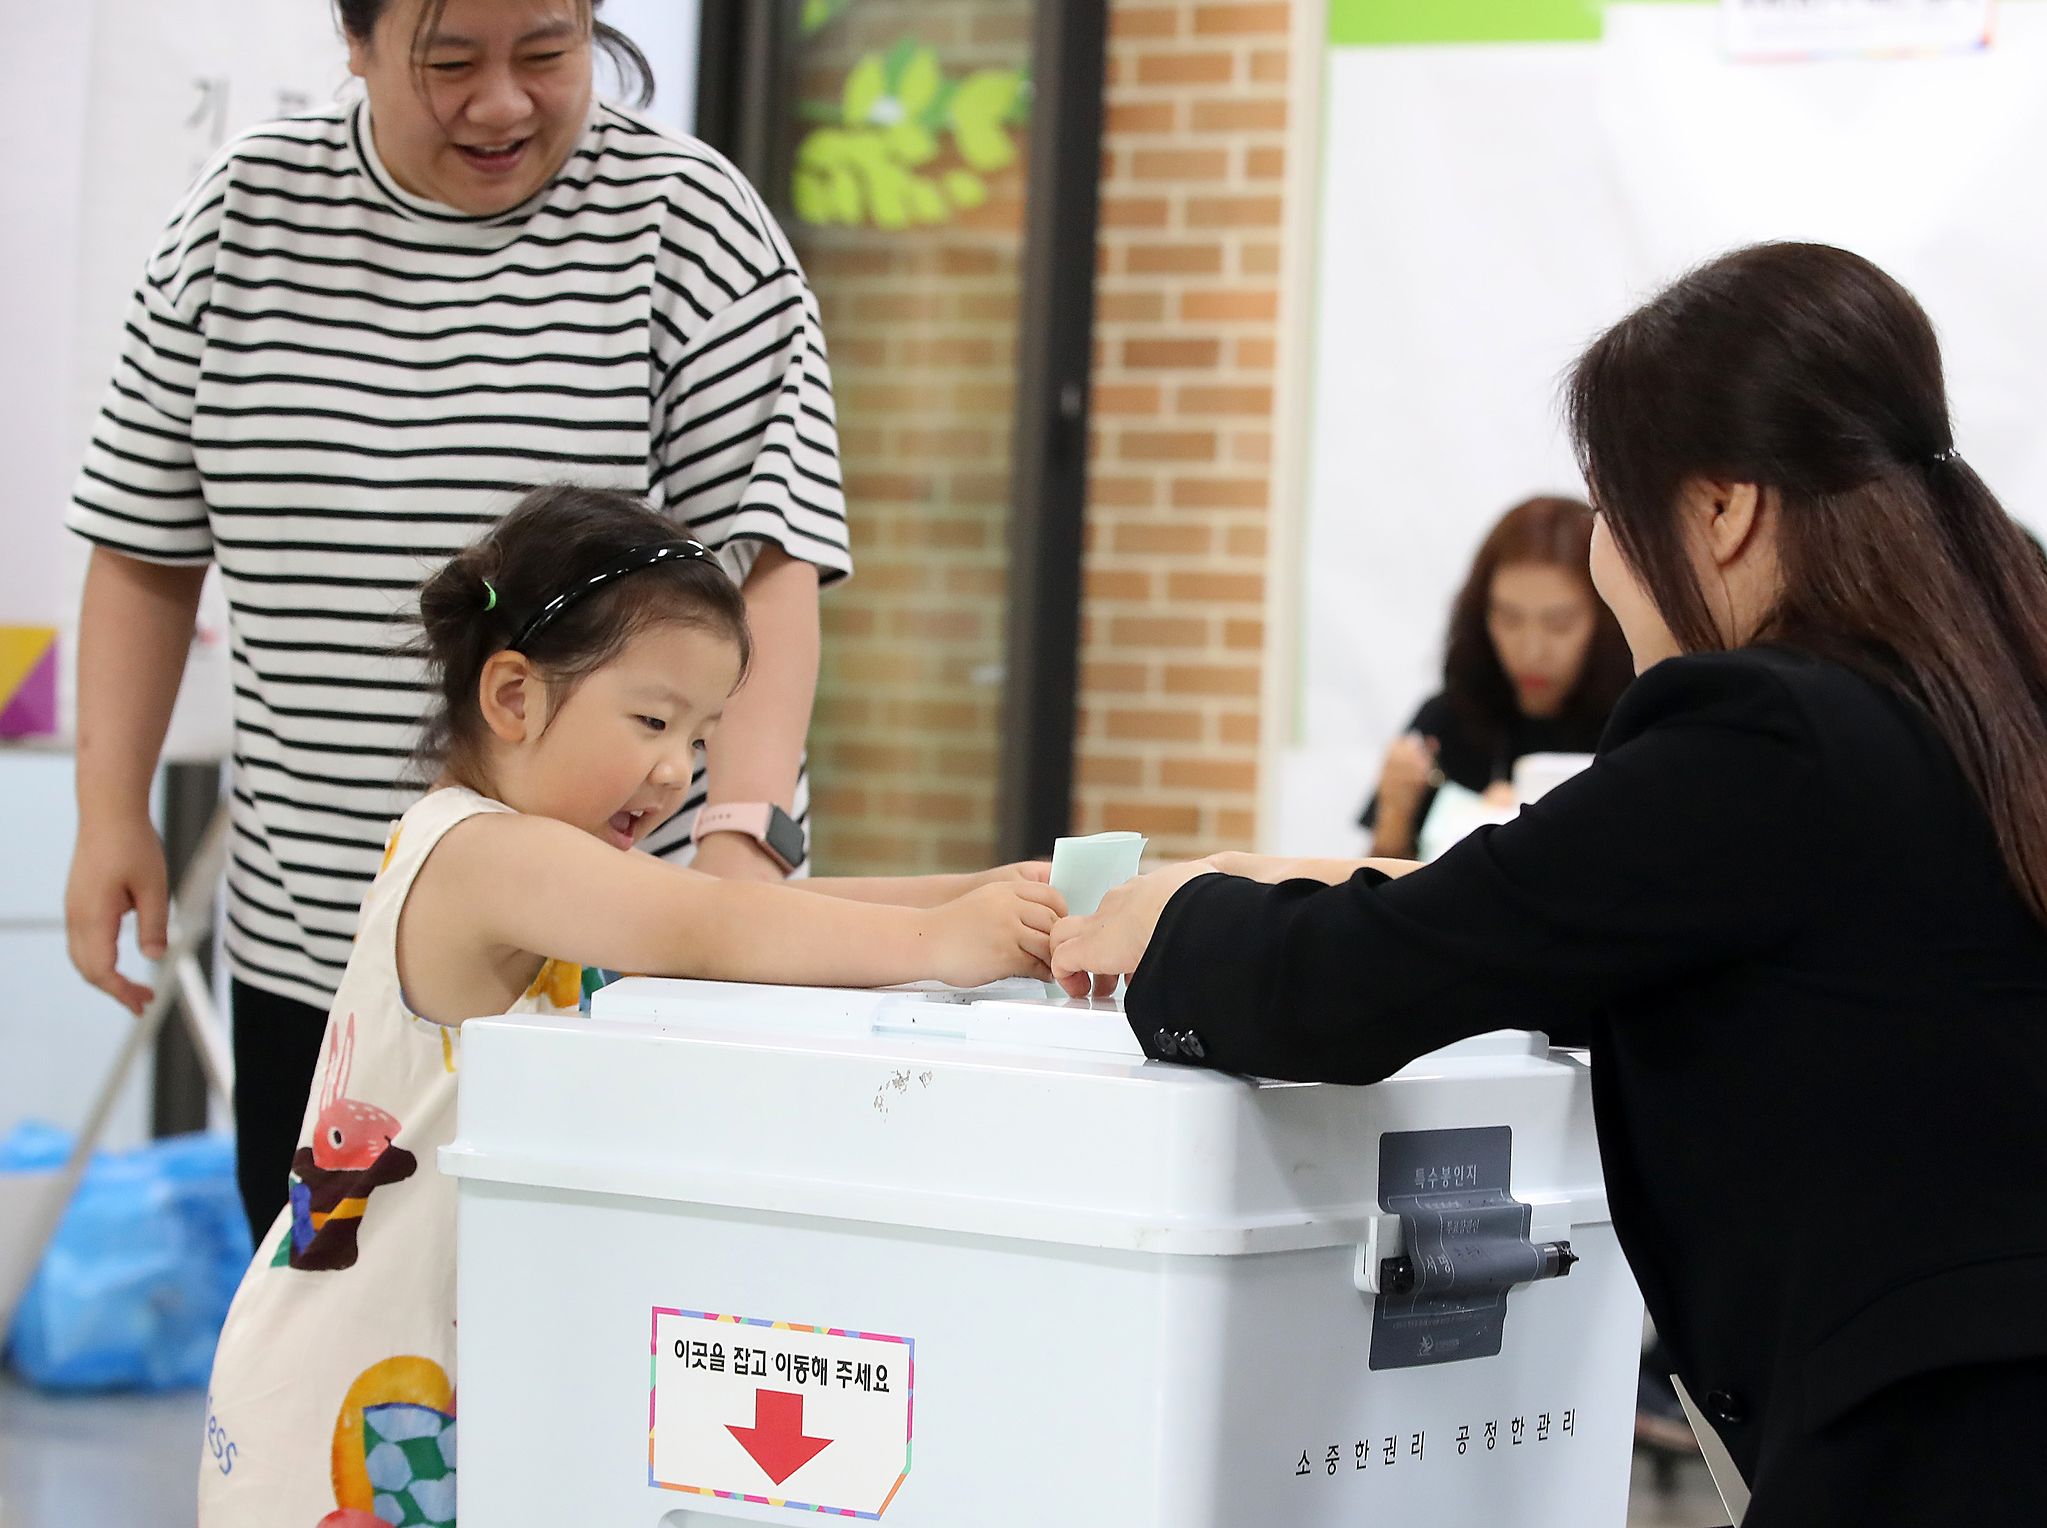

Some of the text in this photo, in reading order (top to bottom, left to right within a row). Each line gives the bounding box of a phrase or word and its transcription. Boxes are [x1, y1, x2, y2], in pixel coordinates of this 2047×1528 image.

[1415, 1164, 1477, 1189] 특수봉인지
[674, 1339, 890, 1393] 이곳을 잡고 이동해 주세요
[1295, 1408, 1576, 1475] 소중한권리 공정한관리
